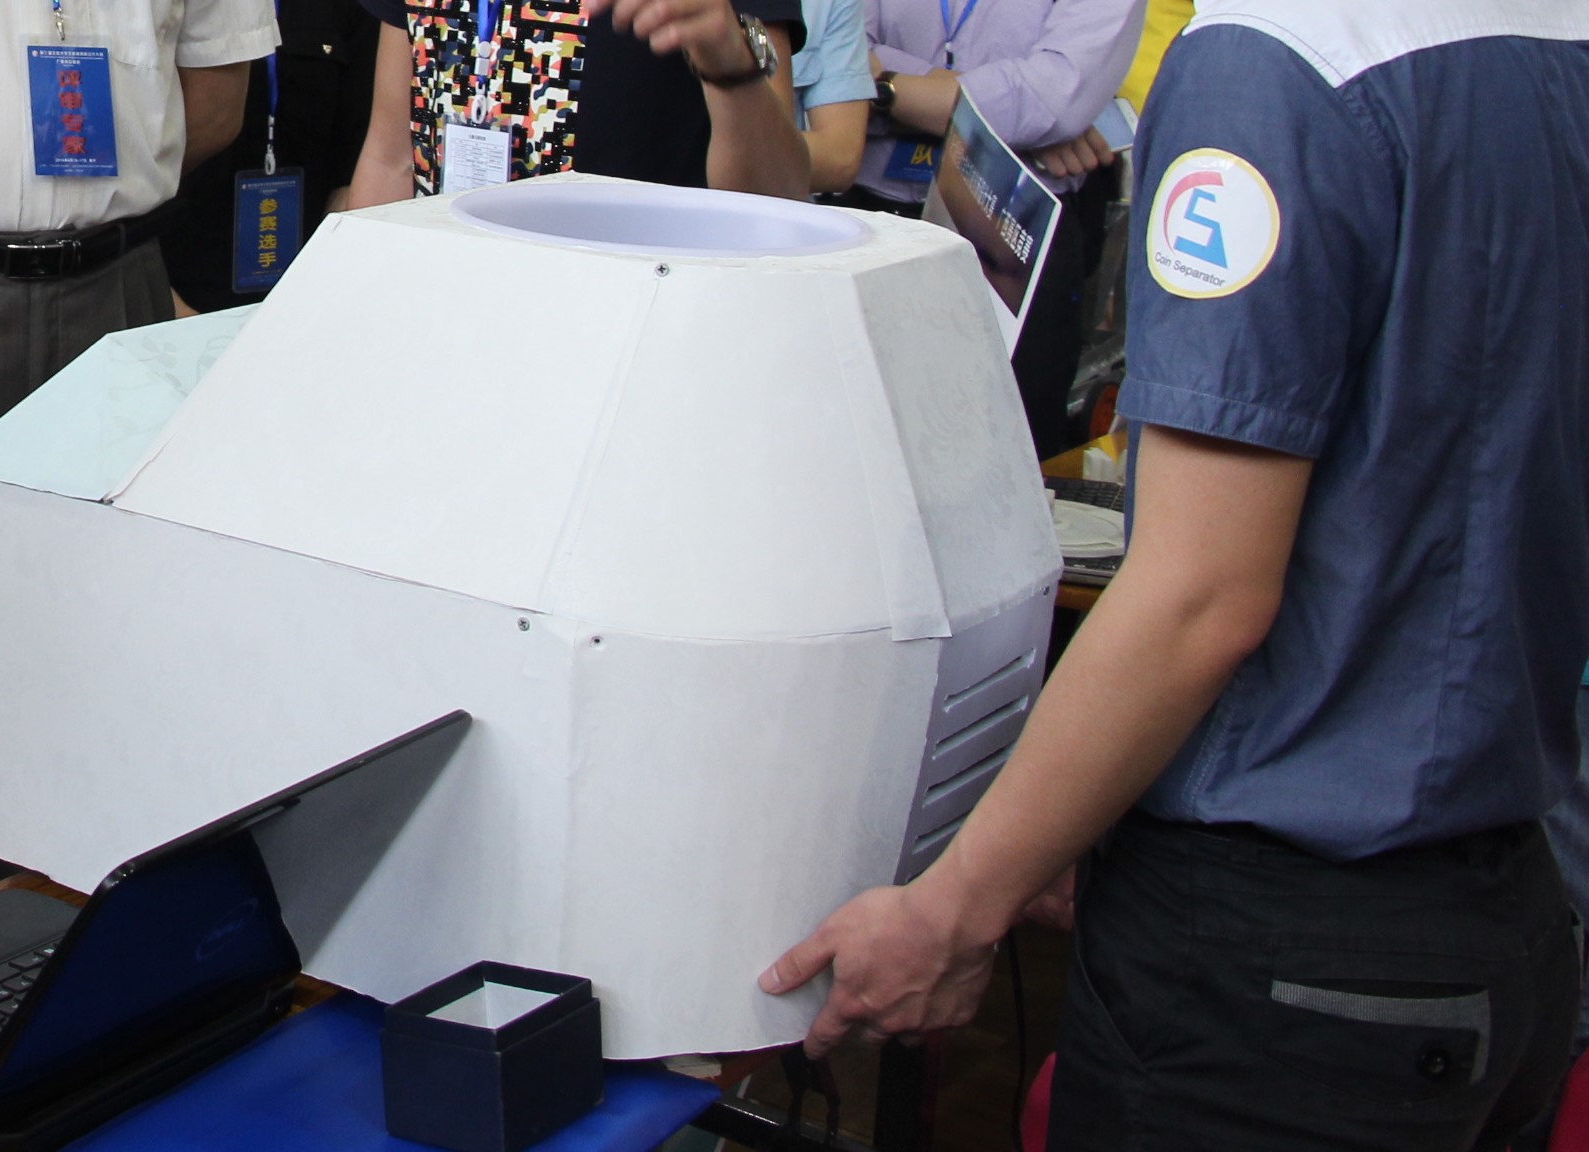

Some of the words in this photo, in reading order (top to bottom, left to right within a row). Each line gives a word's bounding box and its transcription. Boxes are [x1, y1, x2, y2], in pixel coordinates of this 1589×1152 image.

[59, 70, 88, 154] 评审专家
[259, 198, 278, 267] 参赛选手
[1154, 252, 1171, 266] Coin
[1174, 260, 1226, 286] Separator
